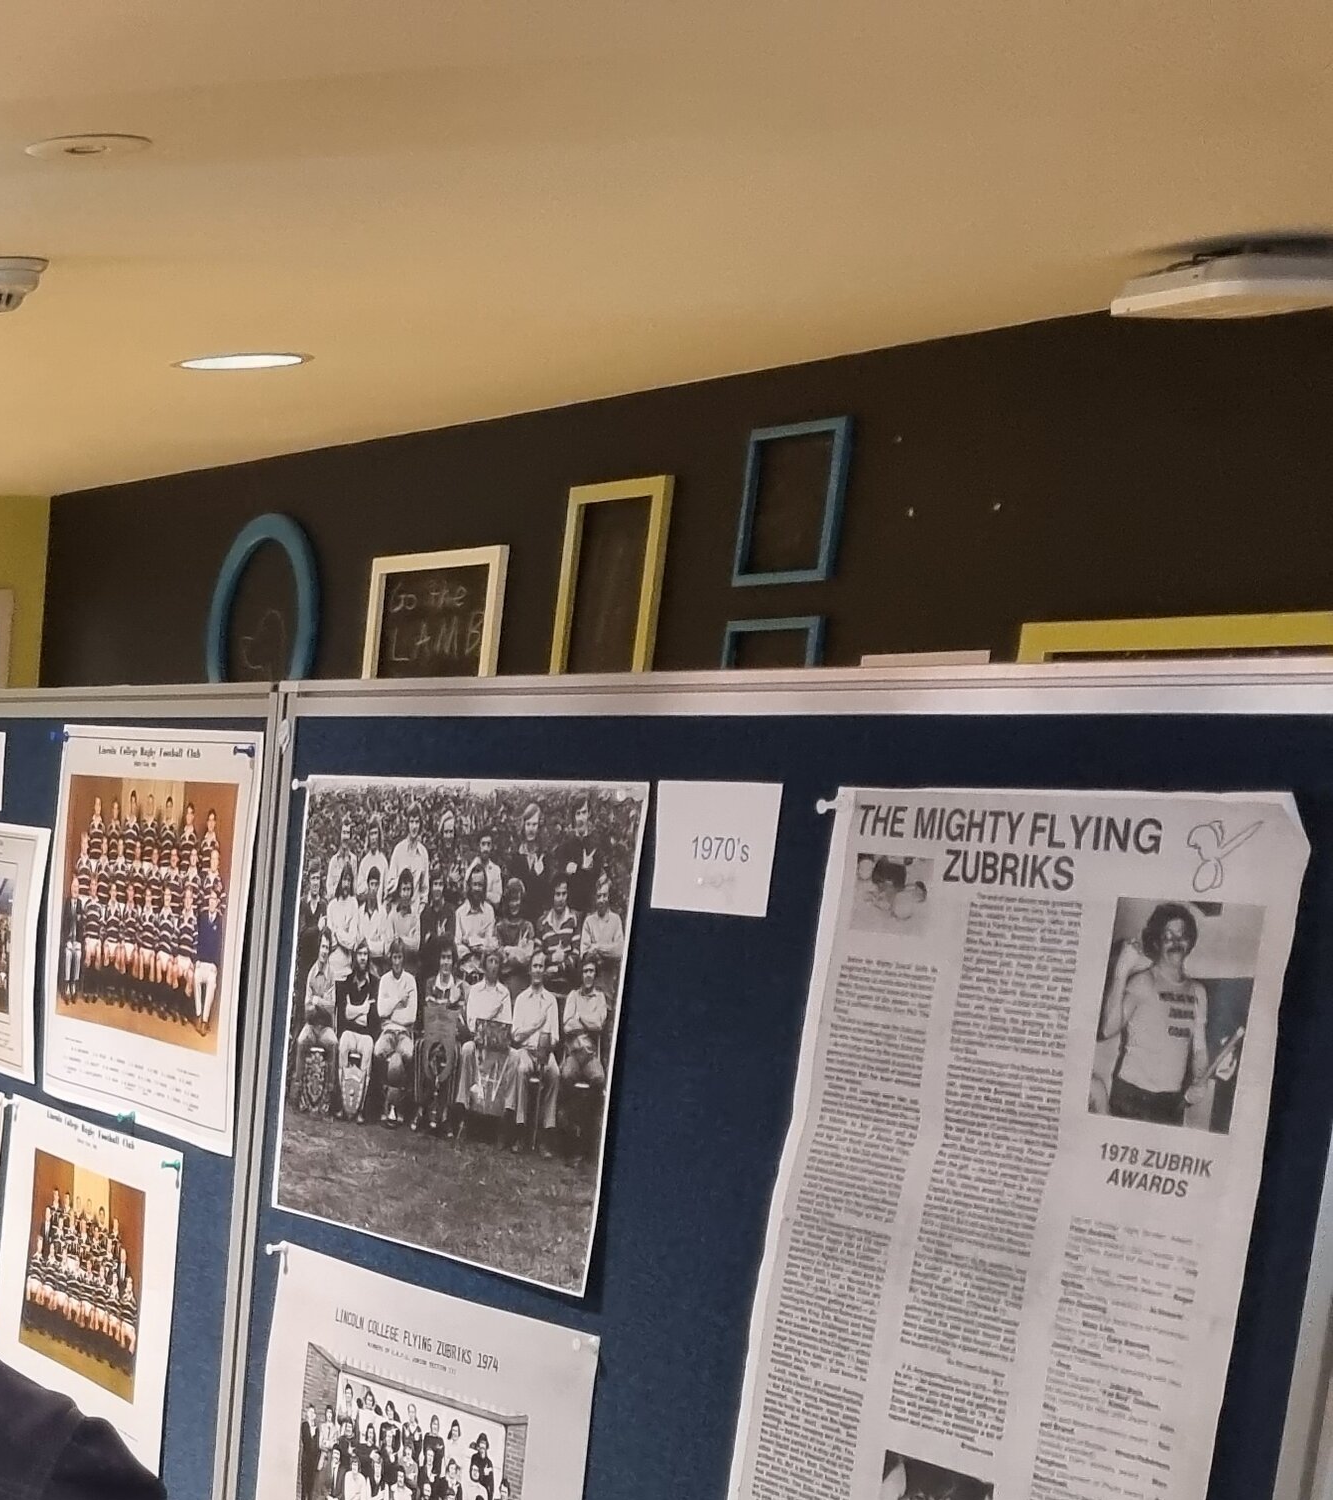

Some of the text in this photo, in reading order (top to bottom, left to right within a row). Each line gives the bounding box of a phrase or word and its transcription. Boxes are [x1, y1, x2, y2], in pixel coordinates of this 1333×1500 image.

[391, 582, 418, 613] Go
[858, 804, 1163, 854] THE MIGHTY FLYING
[691, 834, 750, 863] 1970's
[942, 849, 1075, 892] ZUBRIKS
[1099, 1142, 1213, 1178] 1978 ZUBRIK
[1105, 1170, 1189, 1199] AWARDS
[336, 1307, 499, 1372] LINCOLN COLLEGE FLYING ZUBRIKS 1974
